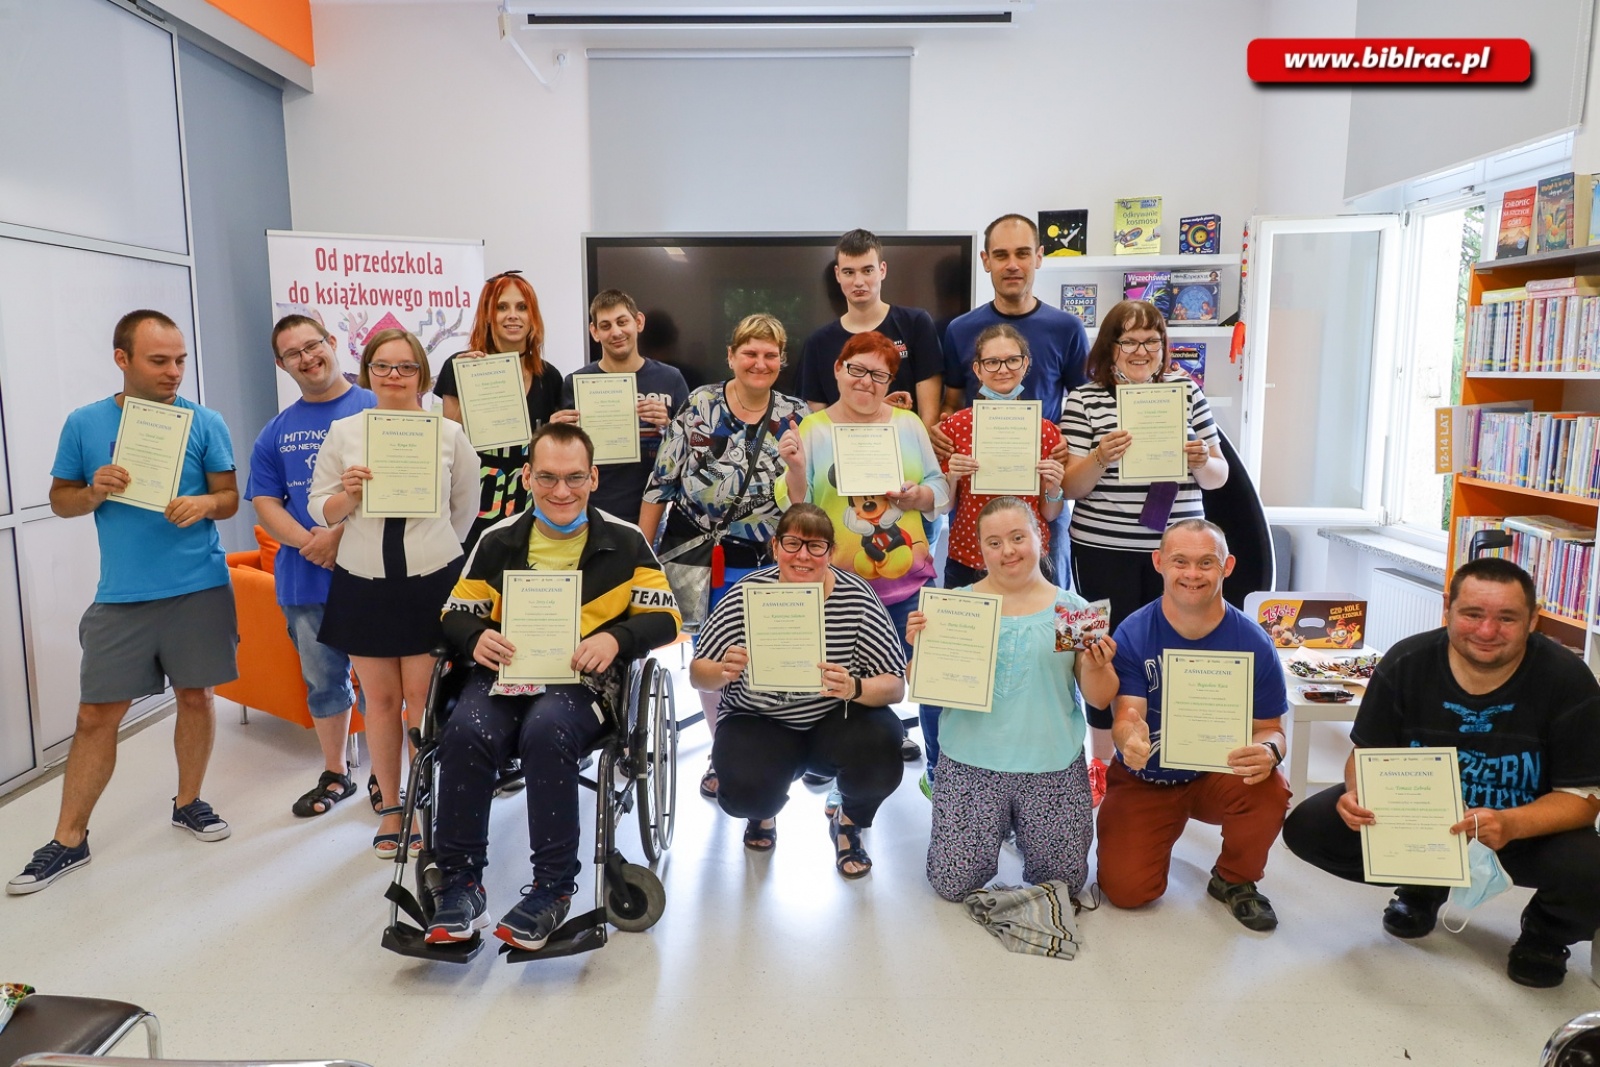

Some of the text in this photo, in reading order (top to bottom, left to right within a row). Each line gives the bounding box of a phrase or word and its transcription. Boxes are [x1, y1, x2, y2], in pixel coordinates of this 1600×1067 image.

[1126, 218, 1158, 226] kosmosu
[315, 247, 443, 277] Od przedszkola
[288, 280, 471, 312] do książkowego mola
[1440, 413, 1449, 469] 12-14 LAT
[631, 590, 673, 607] TEAM
